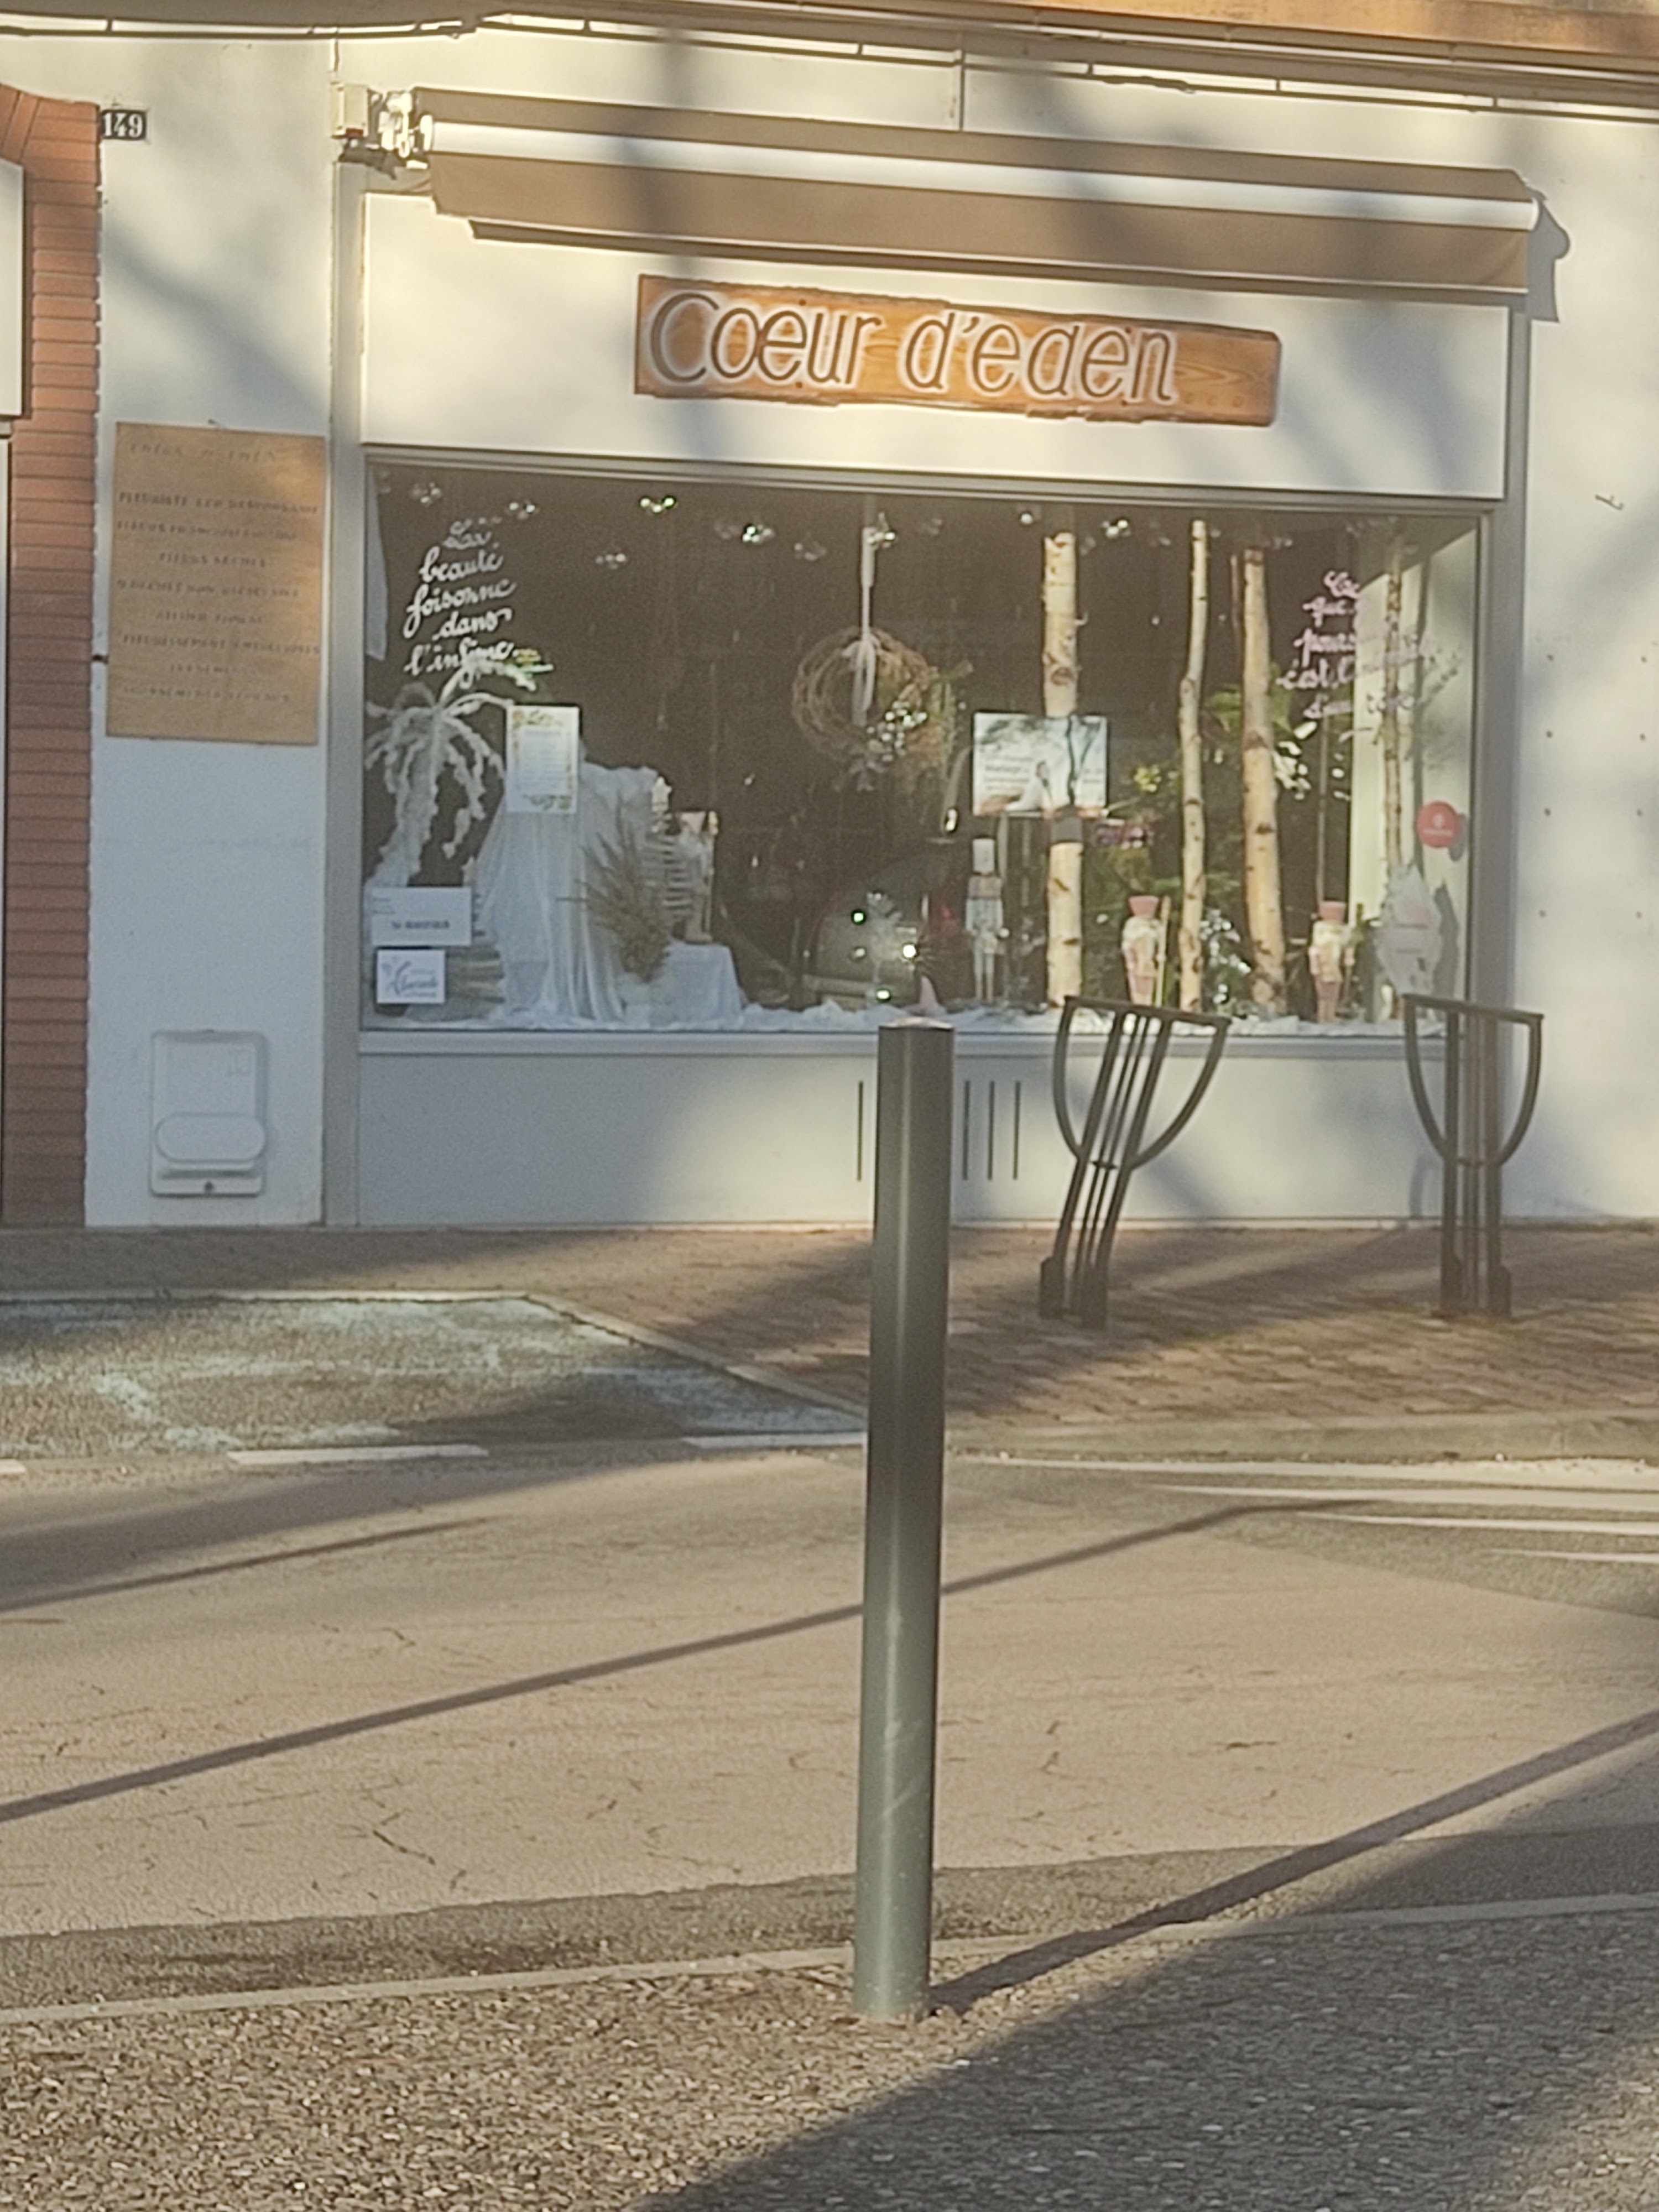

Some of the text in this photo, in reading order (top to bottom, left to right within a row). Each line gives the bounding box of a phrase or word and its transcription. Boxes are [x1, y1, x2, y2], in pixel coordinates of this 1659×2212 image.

[103, 112, 143, 138] 149
[904, 311, 1173, 403] d'eden
[419, 542, 504, 583] beauté
[403, 578, 518, 639] foisonne
[431, 607, 513, 641] dans
